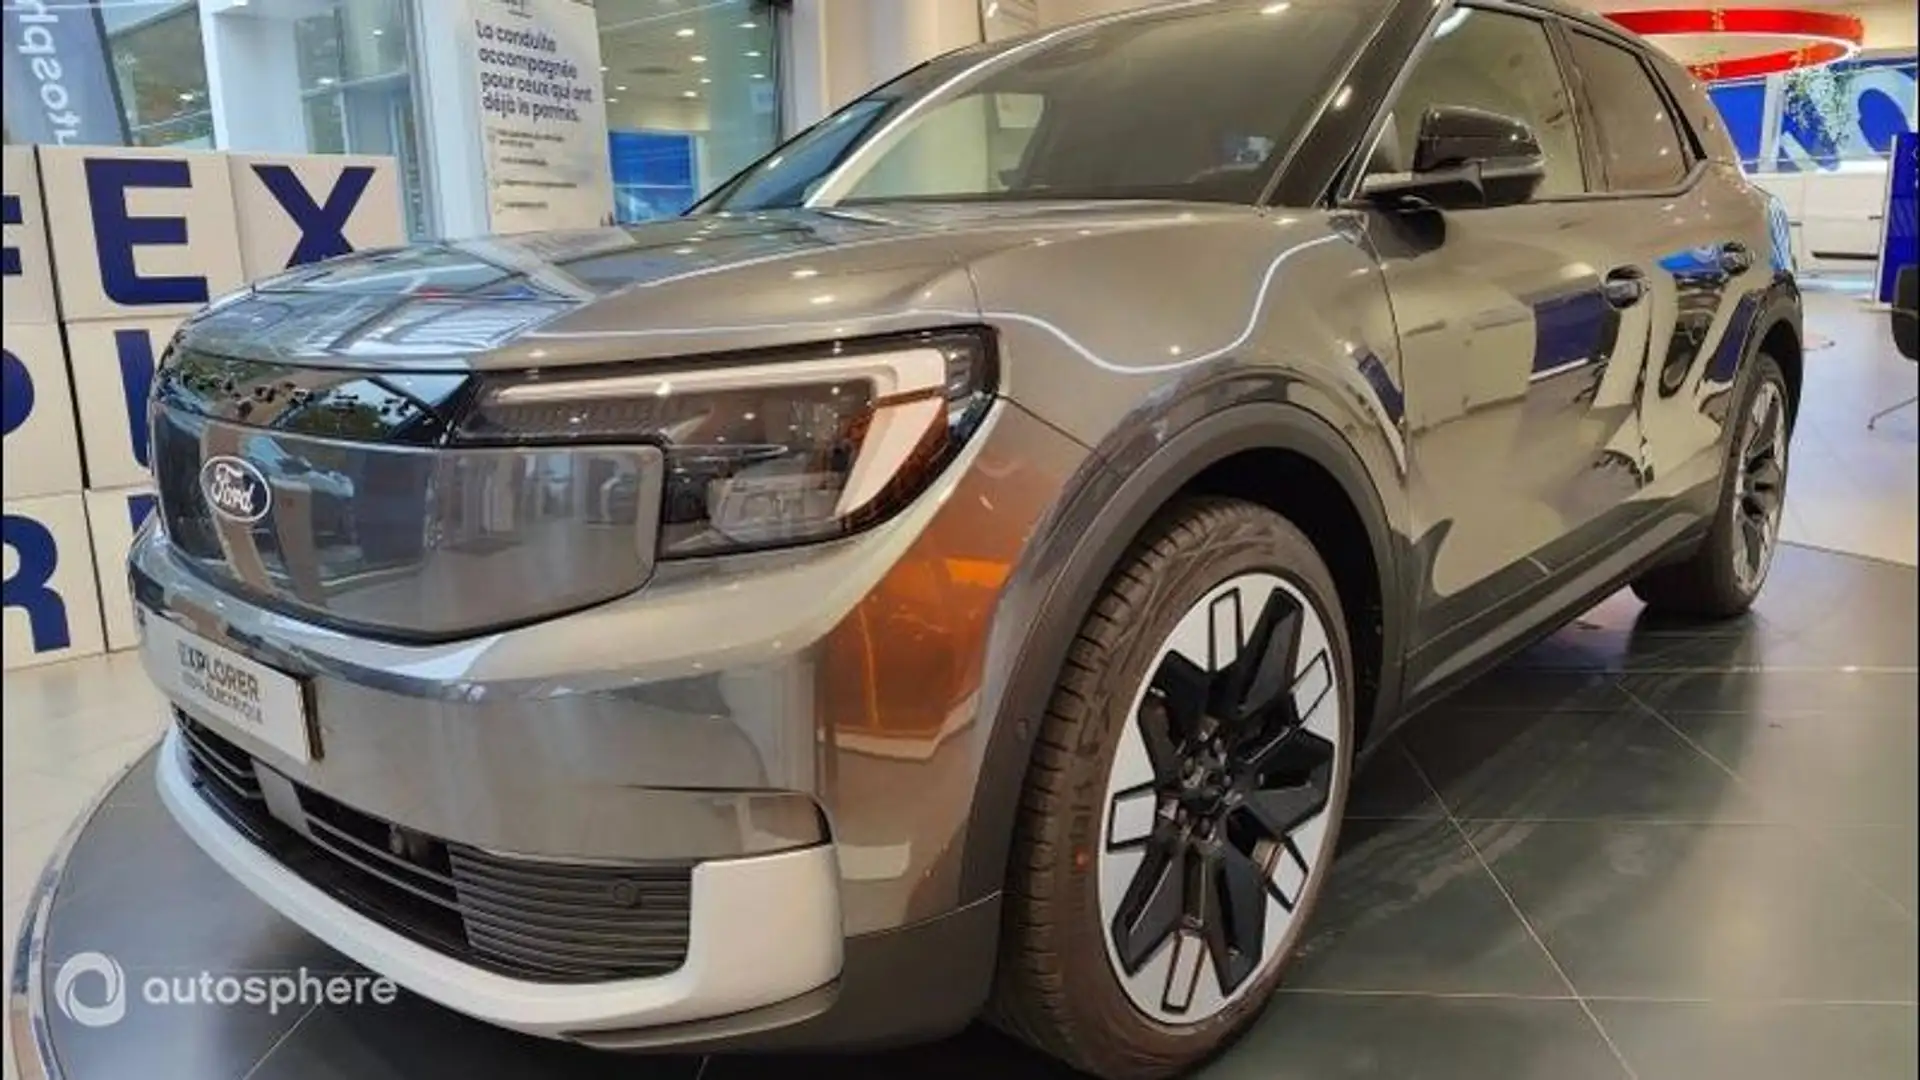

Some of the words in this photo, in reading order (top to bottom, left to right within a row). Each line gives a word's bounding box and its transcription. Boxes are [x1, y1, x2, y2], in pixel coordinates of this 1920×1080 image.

[475, 20, 493, 39] La
[497, 27, 556, 53] conduite
[481, 72, 515, 92] pour
[517, 79, 550, 96] ceux
[551, 80, 570, 103] qui
[482, 93, 516, 119] déjà
[178, 640, 260, 701] EXPLORER
